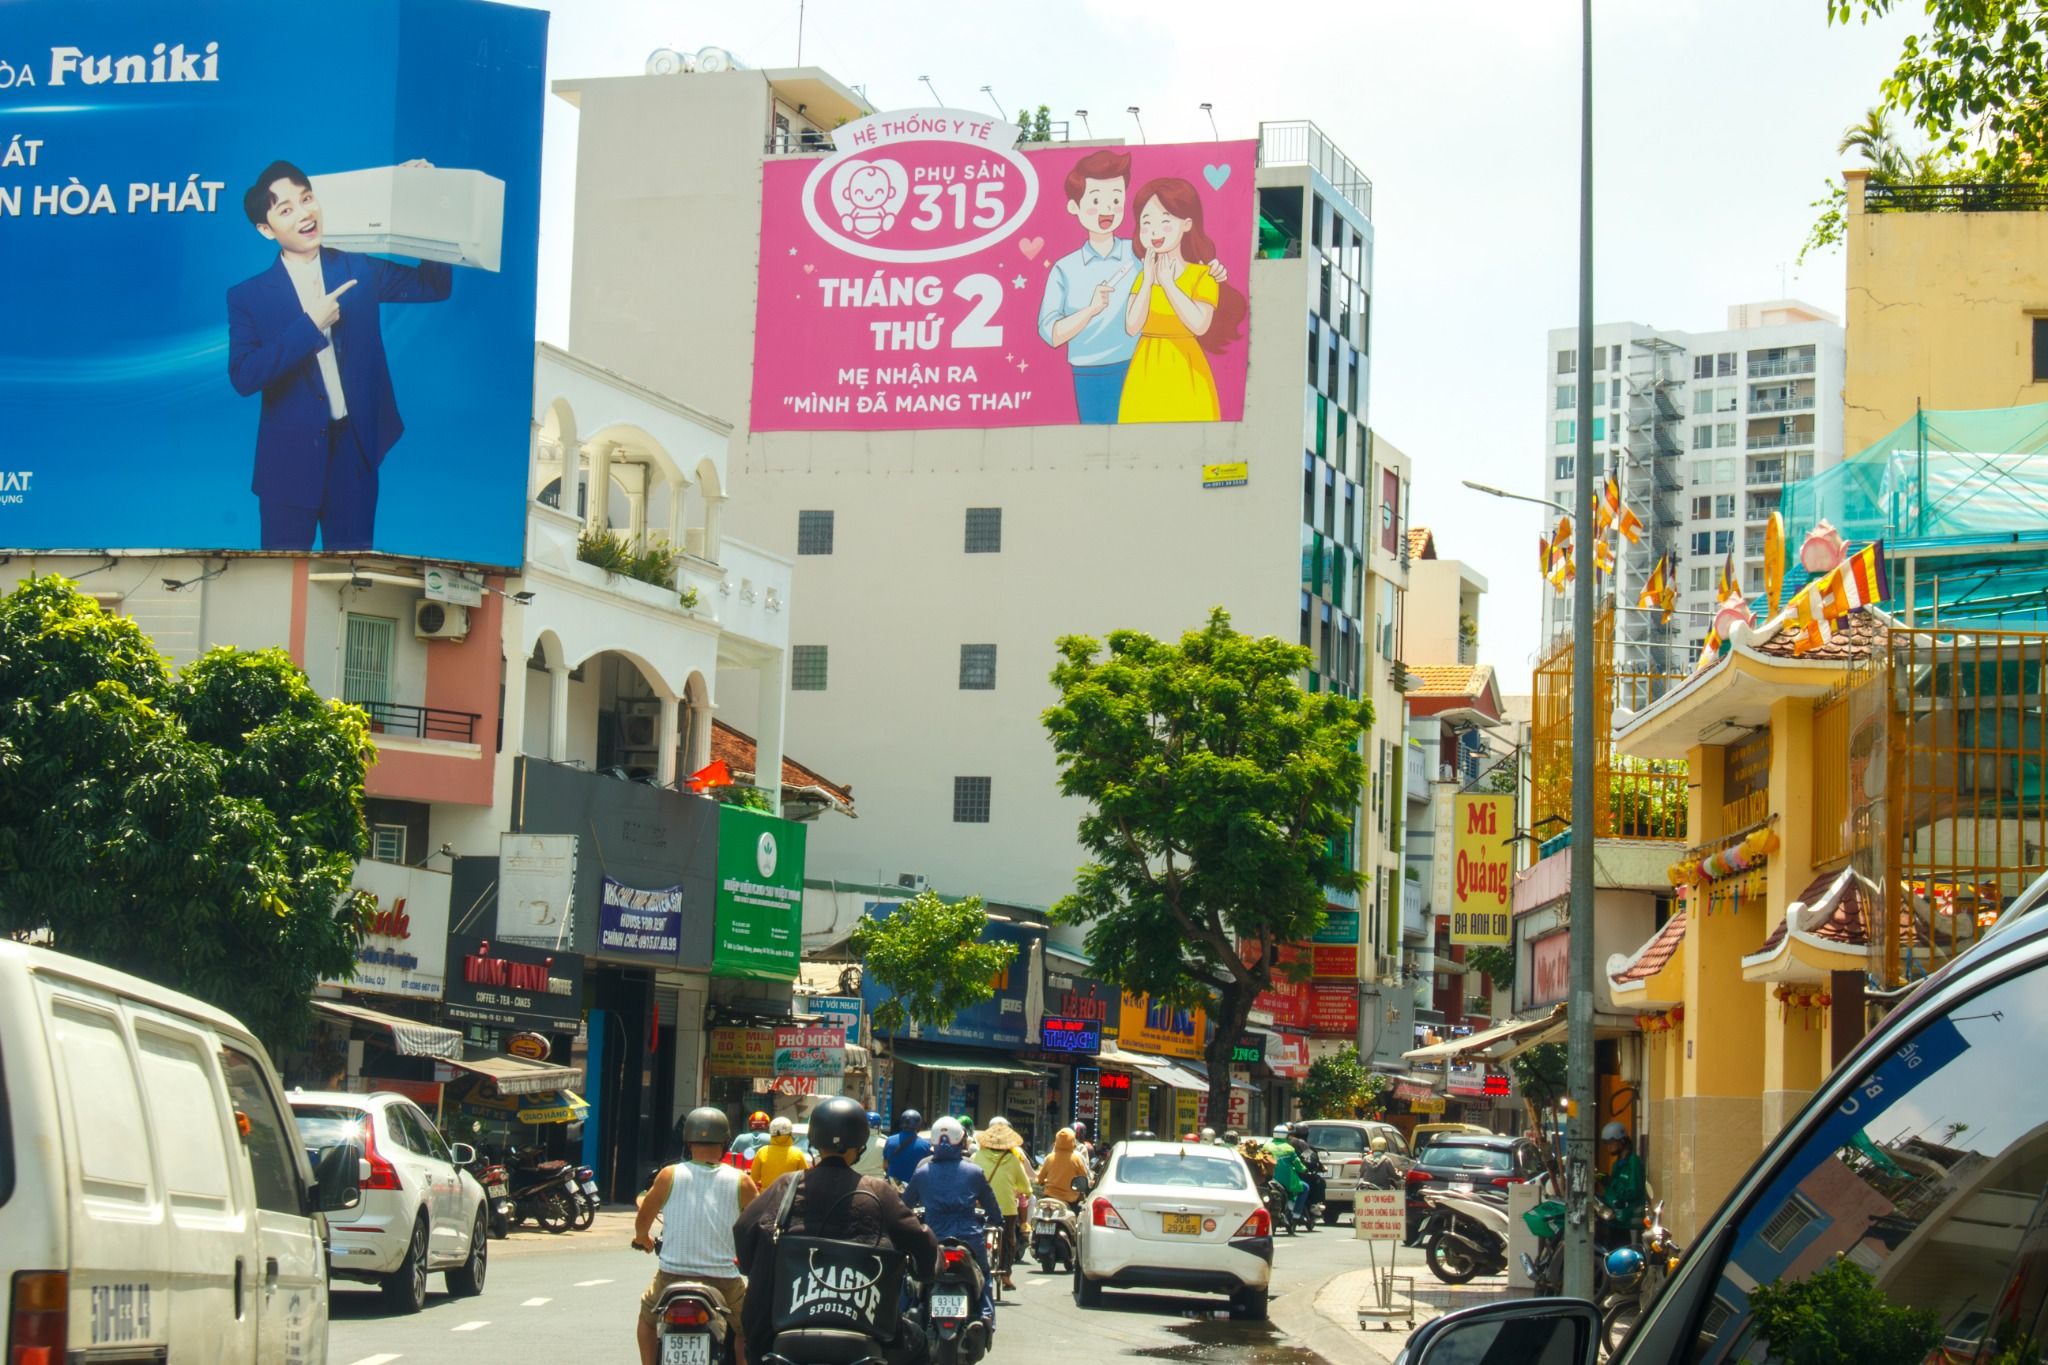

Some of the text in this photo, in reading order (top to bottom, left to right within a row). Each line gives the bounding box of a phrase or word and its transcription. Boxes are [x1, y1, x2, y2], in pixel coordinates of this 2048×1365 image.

[48, 41, 219, 86] Funiki
[853, 112, 995, 145] HỆ THỐNG Y TẾ
[914, 160, 1006, 184] PHỤ SẢN
[33, 177, 117, 215] HÒA
[128, 173, 225, 213] PHÁT
[911, 181, 1005, 232] 315
[818, 270, 944, 307] THÁNG
[870, 273, 1004, 351] THỨ 2
[838, 363, 978, 390] MẸ NHẬN RA
[857, 392, 888, 413] ĐÃ
[896, 394, 961, 413] MANG
[1467, 801, 1496, 835] Mì
[1456, 845, 1508, 905] Quảng
[620, 913, 641, 929] HOUSE
[1455, 912, 1508, 936] BA ANH EM
[602, 928, 625, 947] CHÍNH
[475, 991, 496, 1006] COFFEE
[500, 995, 511, 1007] TEA
[514, 997, 532, 1009] CAKES
[809, 998, 859, 1010] HÁT VỚI NHAU
[778, 1029, 840, 1047] PHỞ MIẾN
[1044, 1030, 1098, 1051] THẠCH
[789, 1265, 881, 1325] LEAGUE
[809, 1303, 858, 1321] SPOILED
